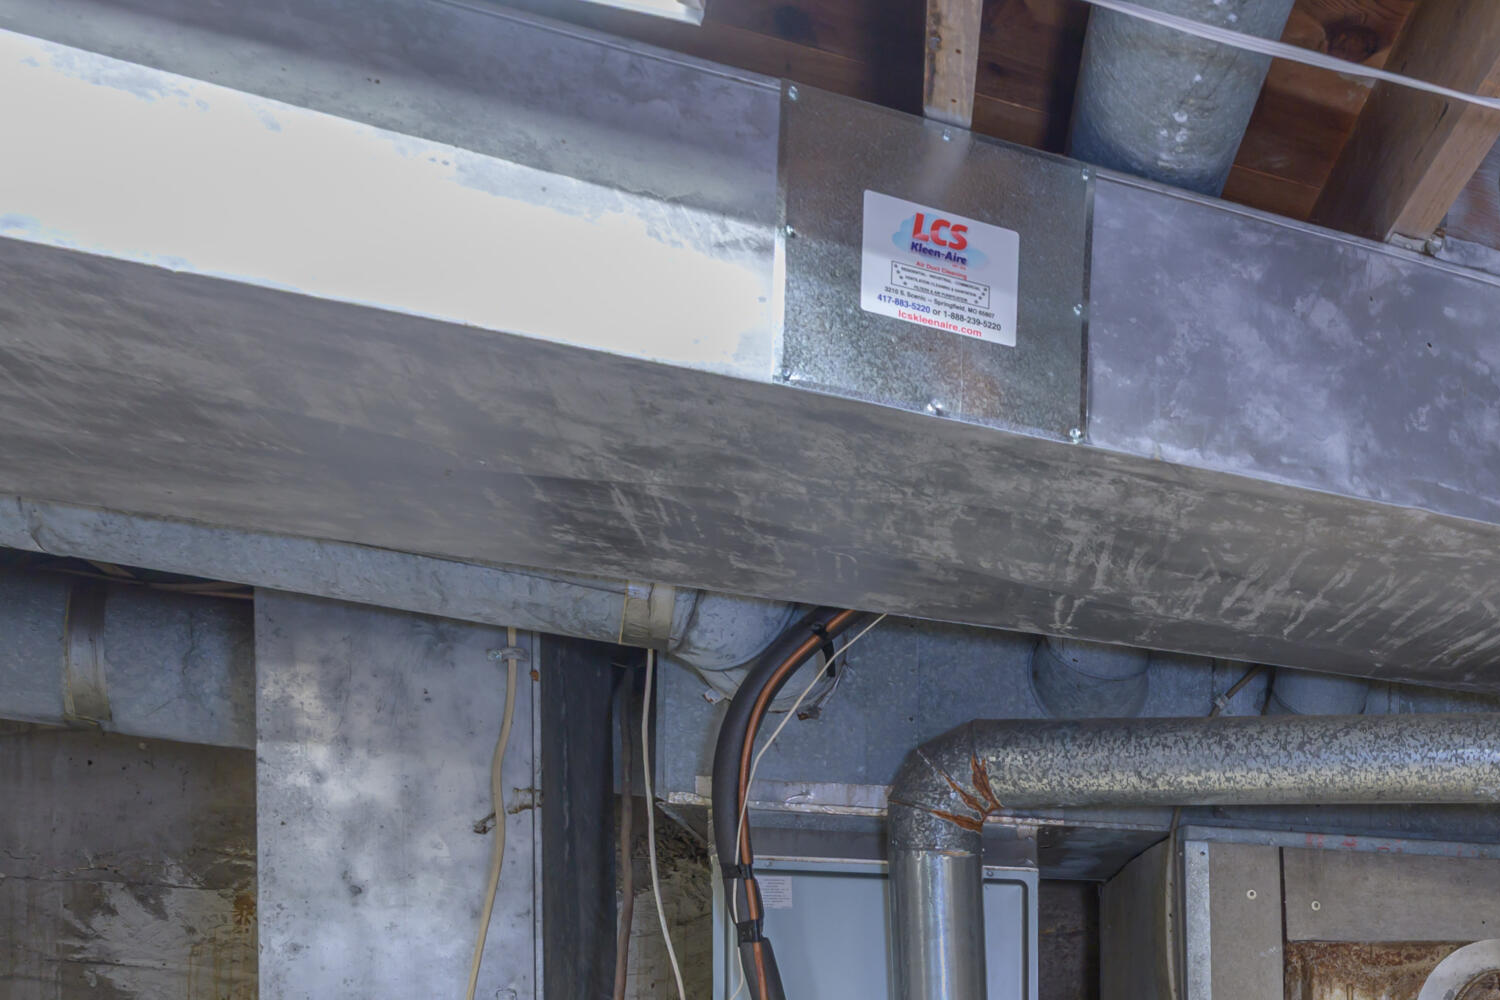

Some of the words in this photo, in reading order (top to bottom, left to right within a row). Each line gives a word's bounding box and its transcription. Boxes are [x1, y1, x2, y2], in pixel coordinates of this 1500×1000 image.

[912, 212, 968, 250] LCS
[910, 241, 967, 265] Kleen-Aire
[927, 264, 940, 272] Duct
[942, 267, 967, 280] Cleaning
[877, 293, 931, 314] 417-883-5220
[932, 308, 941, 316] or
[943, 310, 1002, 331] 1-888-239-5220
[897, 309, 982, 337] lcskleenaire.com
[967, 306, 978, 314] MO
